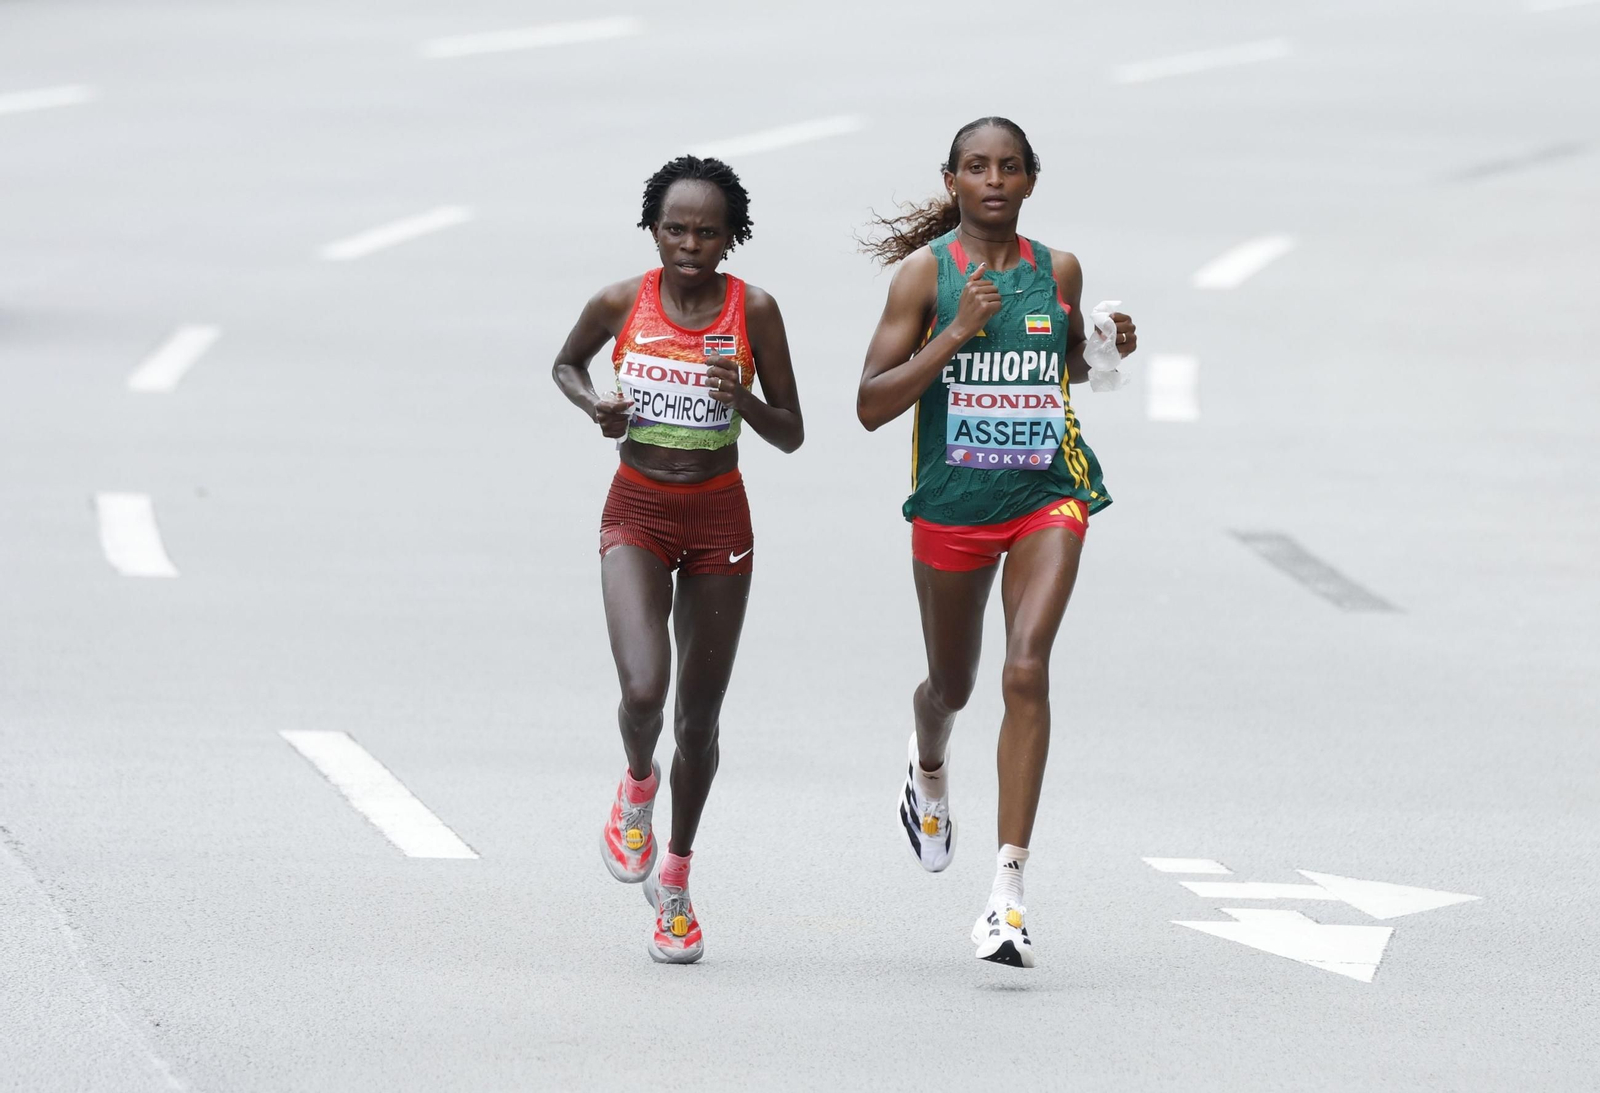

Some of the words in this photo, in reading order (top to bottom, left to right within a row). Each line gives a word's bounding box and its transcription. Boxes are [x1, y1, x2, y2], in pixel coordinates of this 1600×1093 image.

[623, 361, 707, 388] HOND
[942, 350, 1060, 384] ETHIOPIA
[630, 387, 728, 423] EPCHIRCHIR
[950, 391, 1062, 409] HONDA
[953, 419, 1060, 446] ASSEFA
